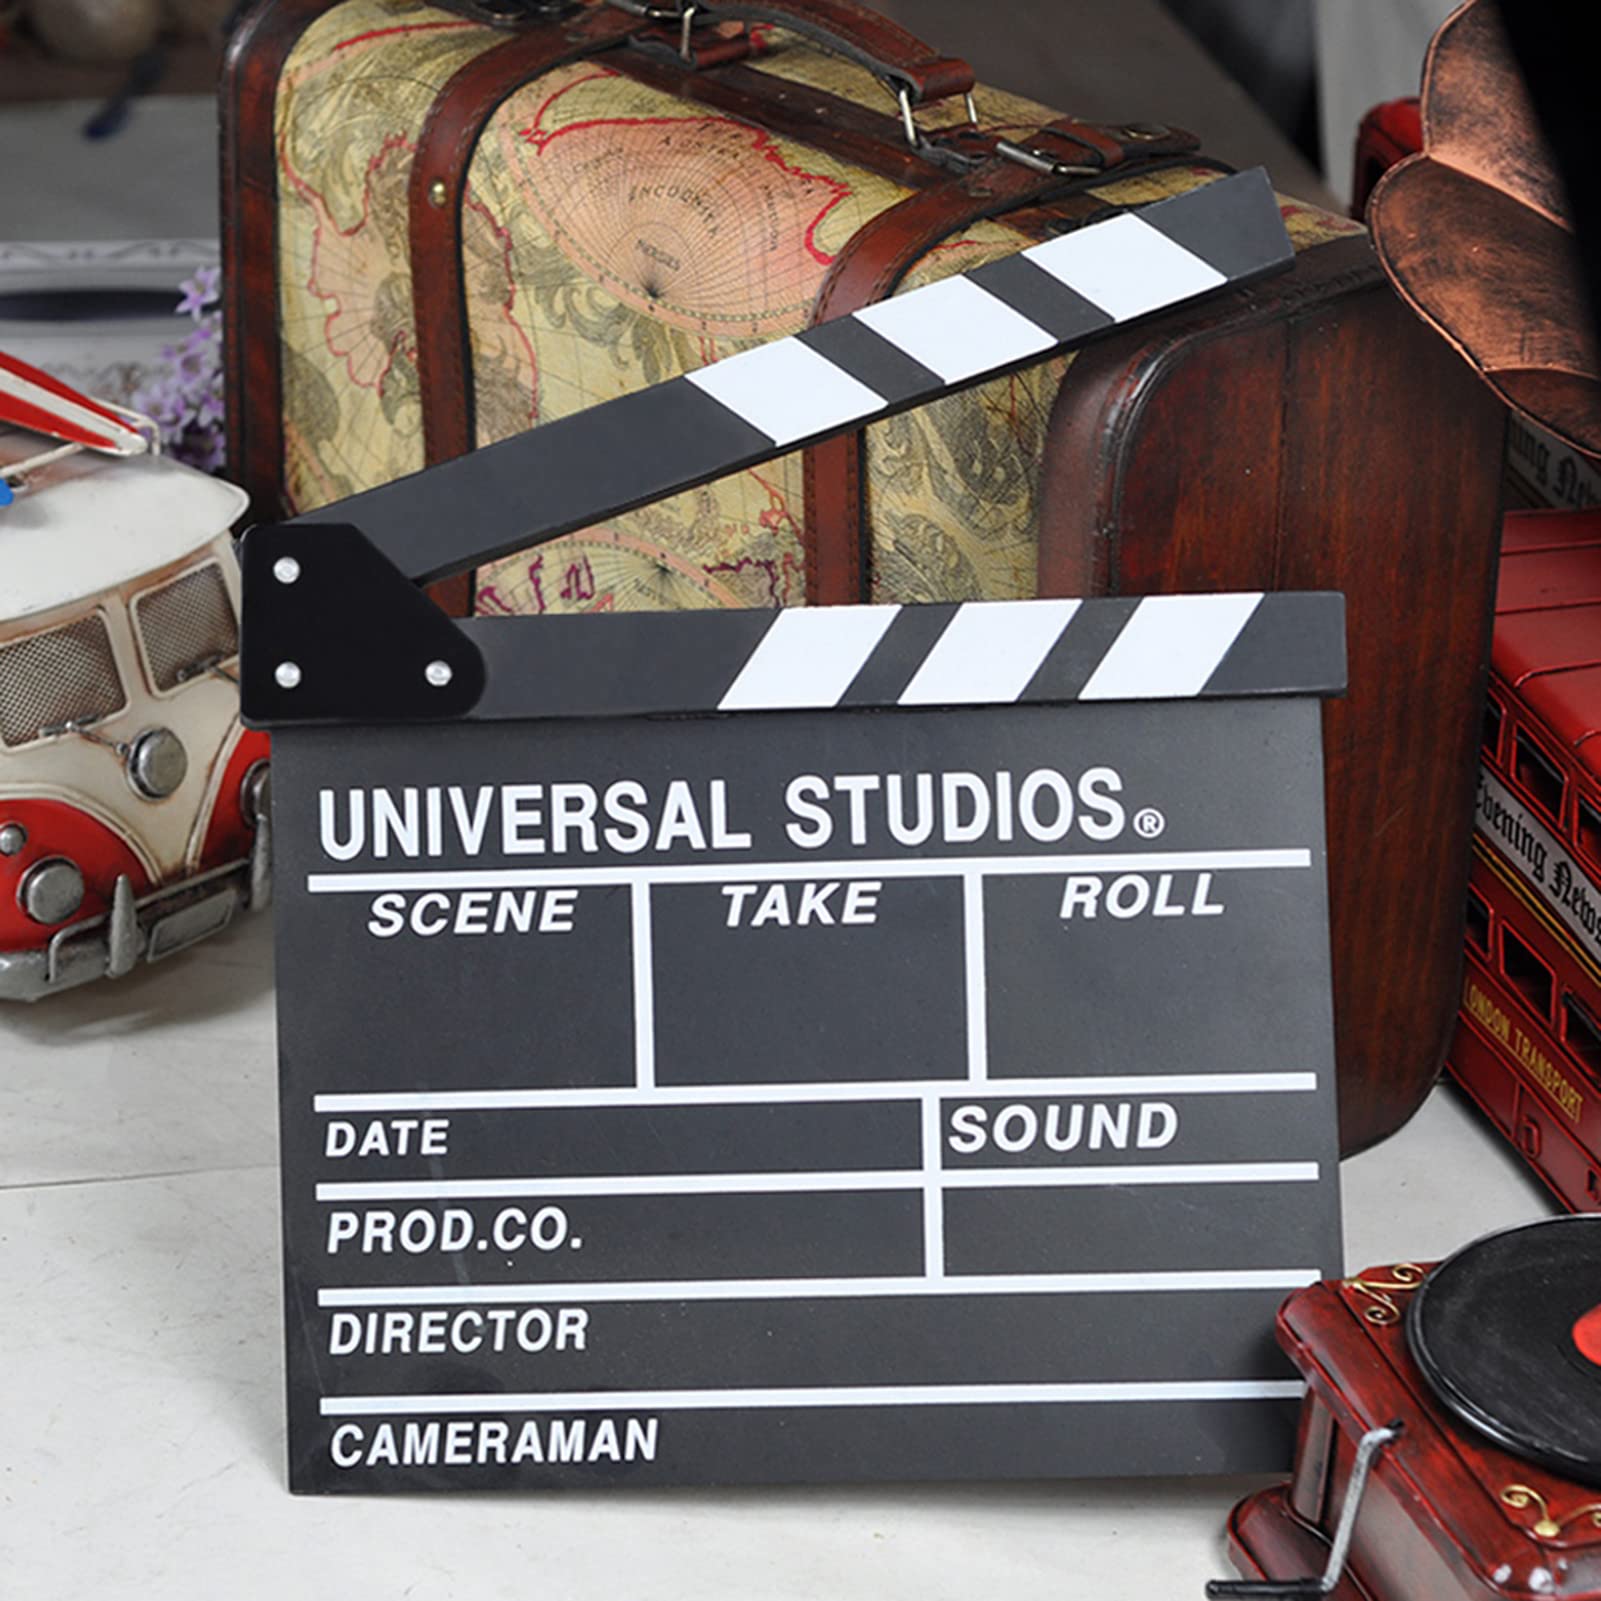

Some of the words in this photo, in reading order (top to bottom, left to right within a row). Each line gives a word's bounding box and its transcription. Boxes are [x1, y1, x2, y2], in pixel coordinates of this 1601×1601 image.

[319, 779, 752, 861] UNIVERSAL
[368, 890, 579, 936] SCENE
[721, 880, 883, 928] TAKE
[1059, 872, 1225, 919] ROLL
[1463, 976, 1511, 1042] LONDON
[1514, 1027, 1584, 1123] TRANSPORT
[324, 1119, 450, 1158] DATE
[948, 1101, 1178, 1154] SOUND
[327, 1206, 582, 1254] PROD.CO.
[329, 1307, 589, 1355] DIRECTOR
[331, 1418, 658, 1467] CAMERAMAN
